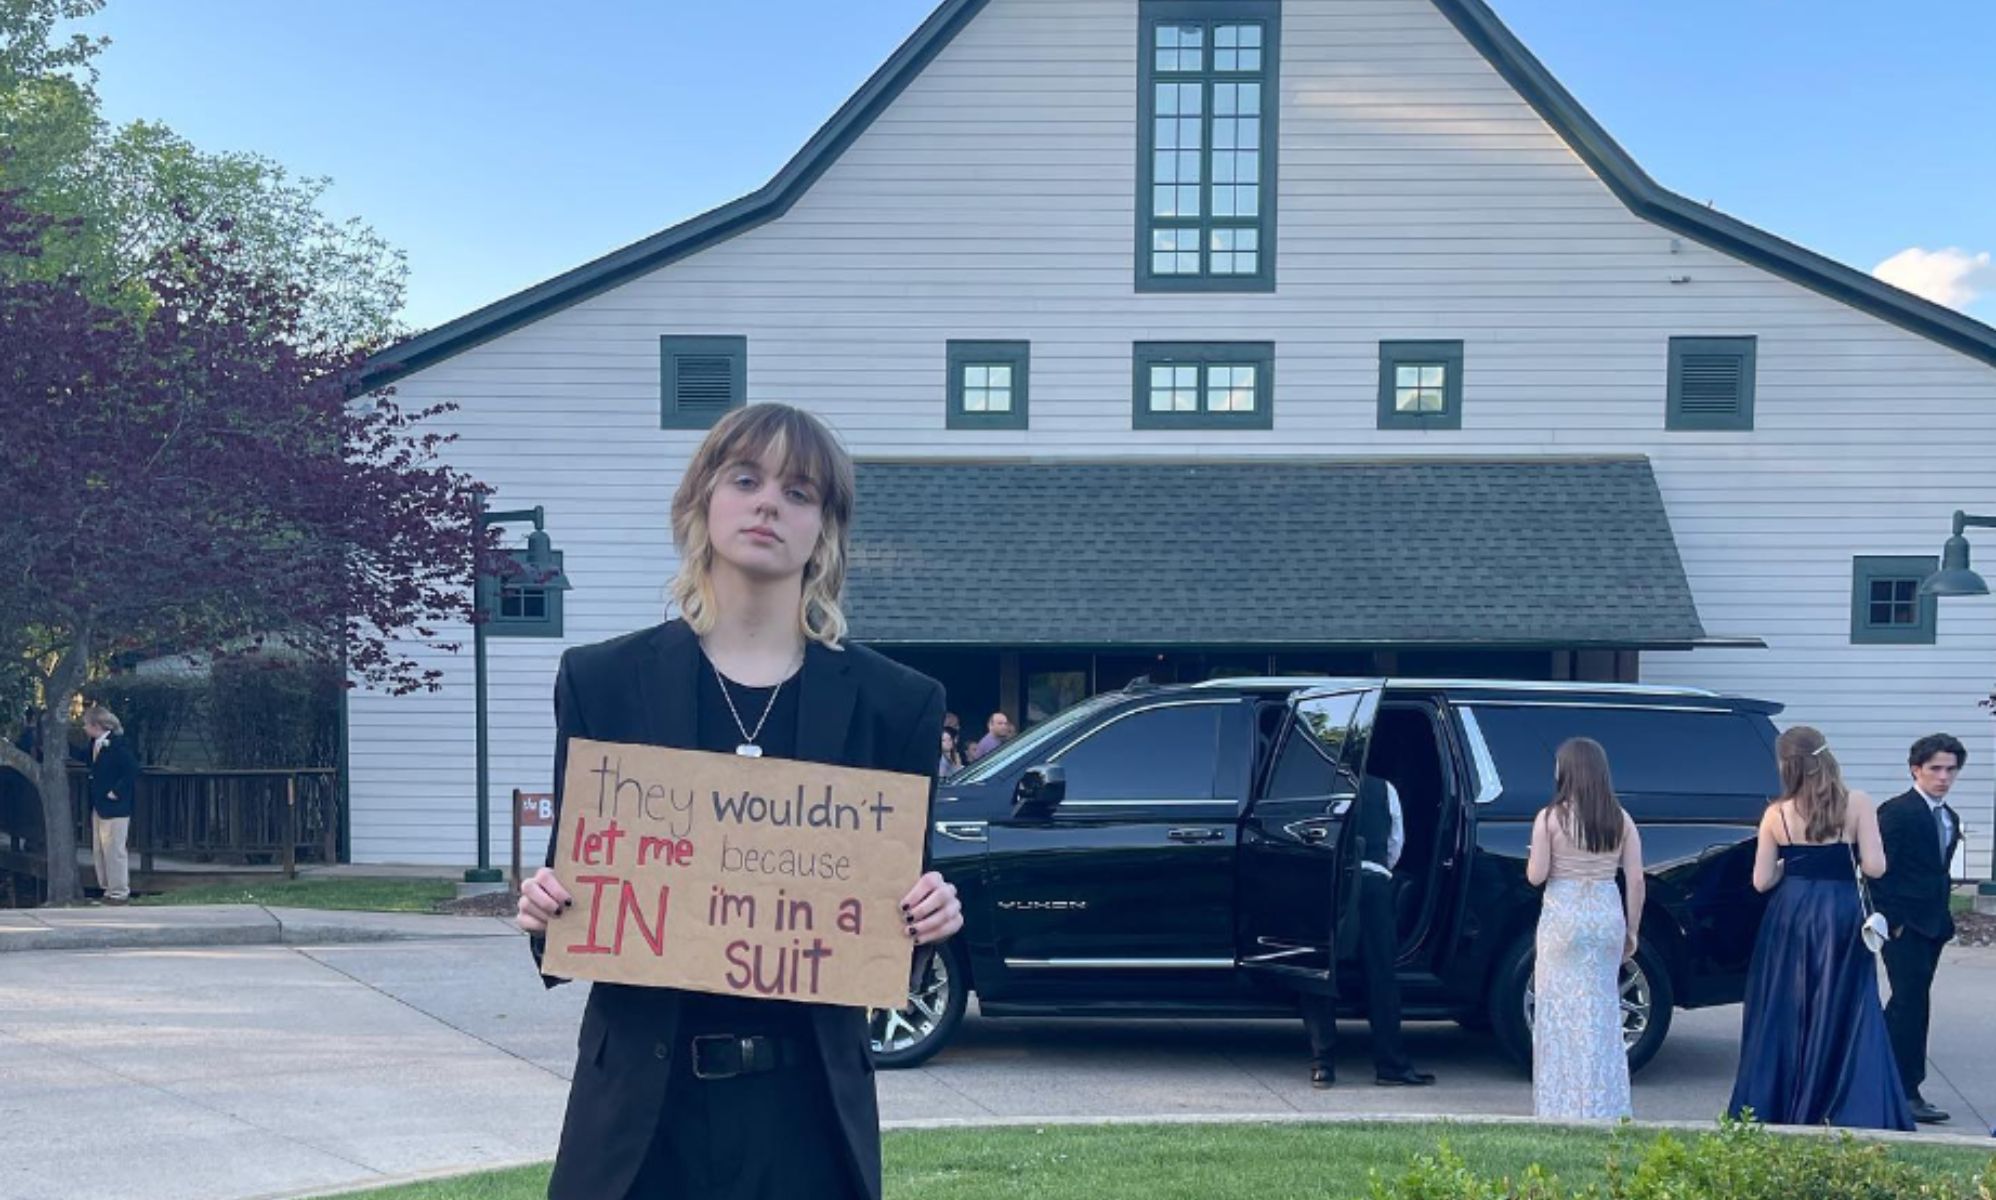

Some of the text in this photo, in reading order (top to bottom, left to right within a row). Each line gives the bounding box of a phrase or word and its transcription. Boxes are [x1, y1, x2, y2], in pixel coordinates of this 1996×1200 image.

[590, 755, 894, 839] they wouldn't
[571, 817, 694, 866] let me
[720, 834, 851, 881] because
[566, 875, 670, 957] IN
[708, 884, 862, 935] i'm in a
[997, 900, 1088, 910] YUKON
[724, 938, 833, 996] suit
